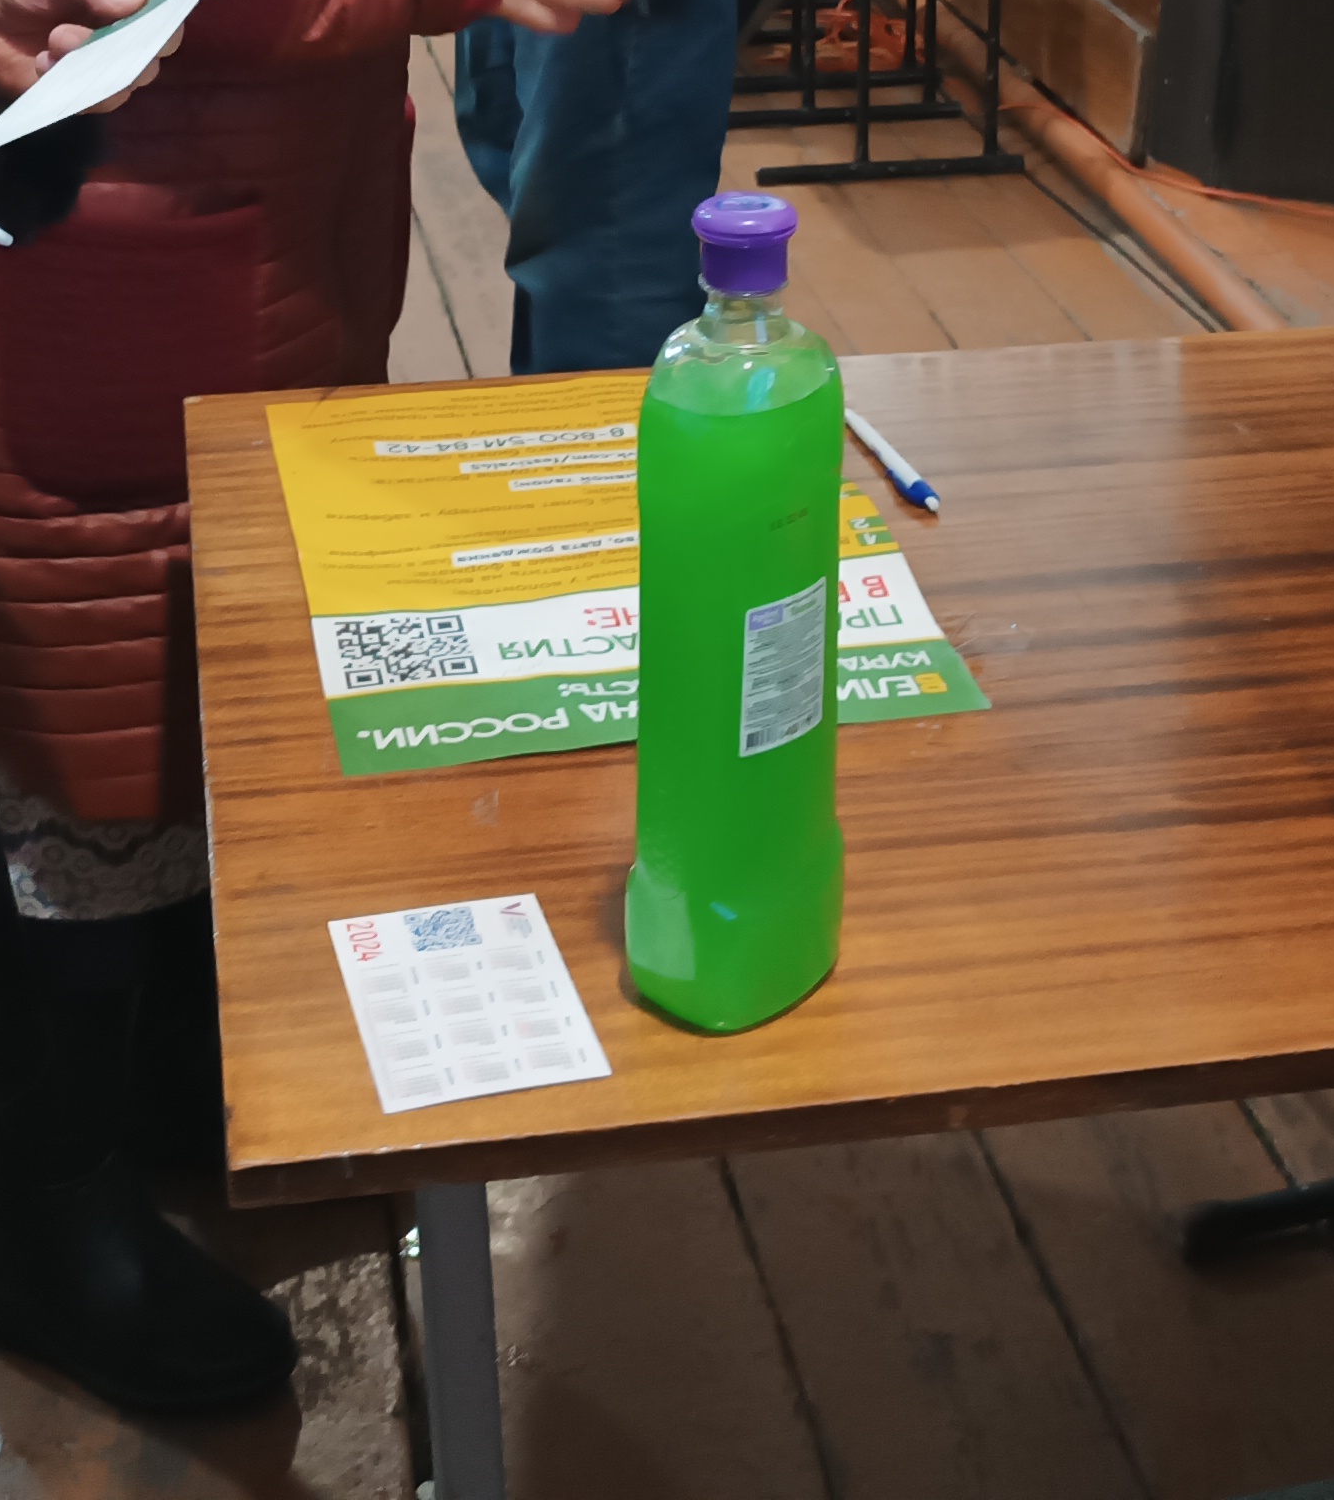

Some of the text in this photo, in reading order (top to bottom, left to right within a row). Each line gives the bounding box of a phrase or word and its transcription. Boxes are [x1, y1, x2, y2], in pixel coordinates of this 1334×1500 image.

[387, 426, 625, 454] 8-800-511-84-42
[497, 631, 639, 661] АСТИЯ
[558, 678, 639, 698] СТЬ:
[838, 672, 948, 701] ВЕЛИ
[356, 706, 571, 750] РОССИИ.
[346, 920, 384, 962] 2024
